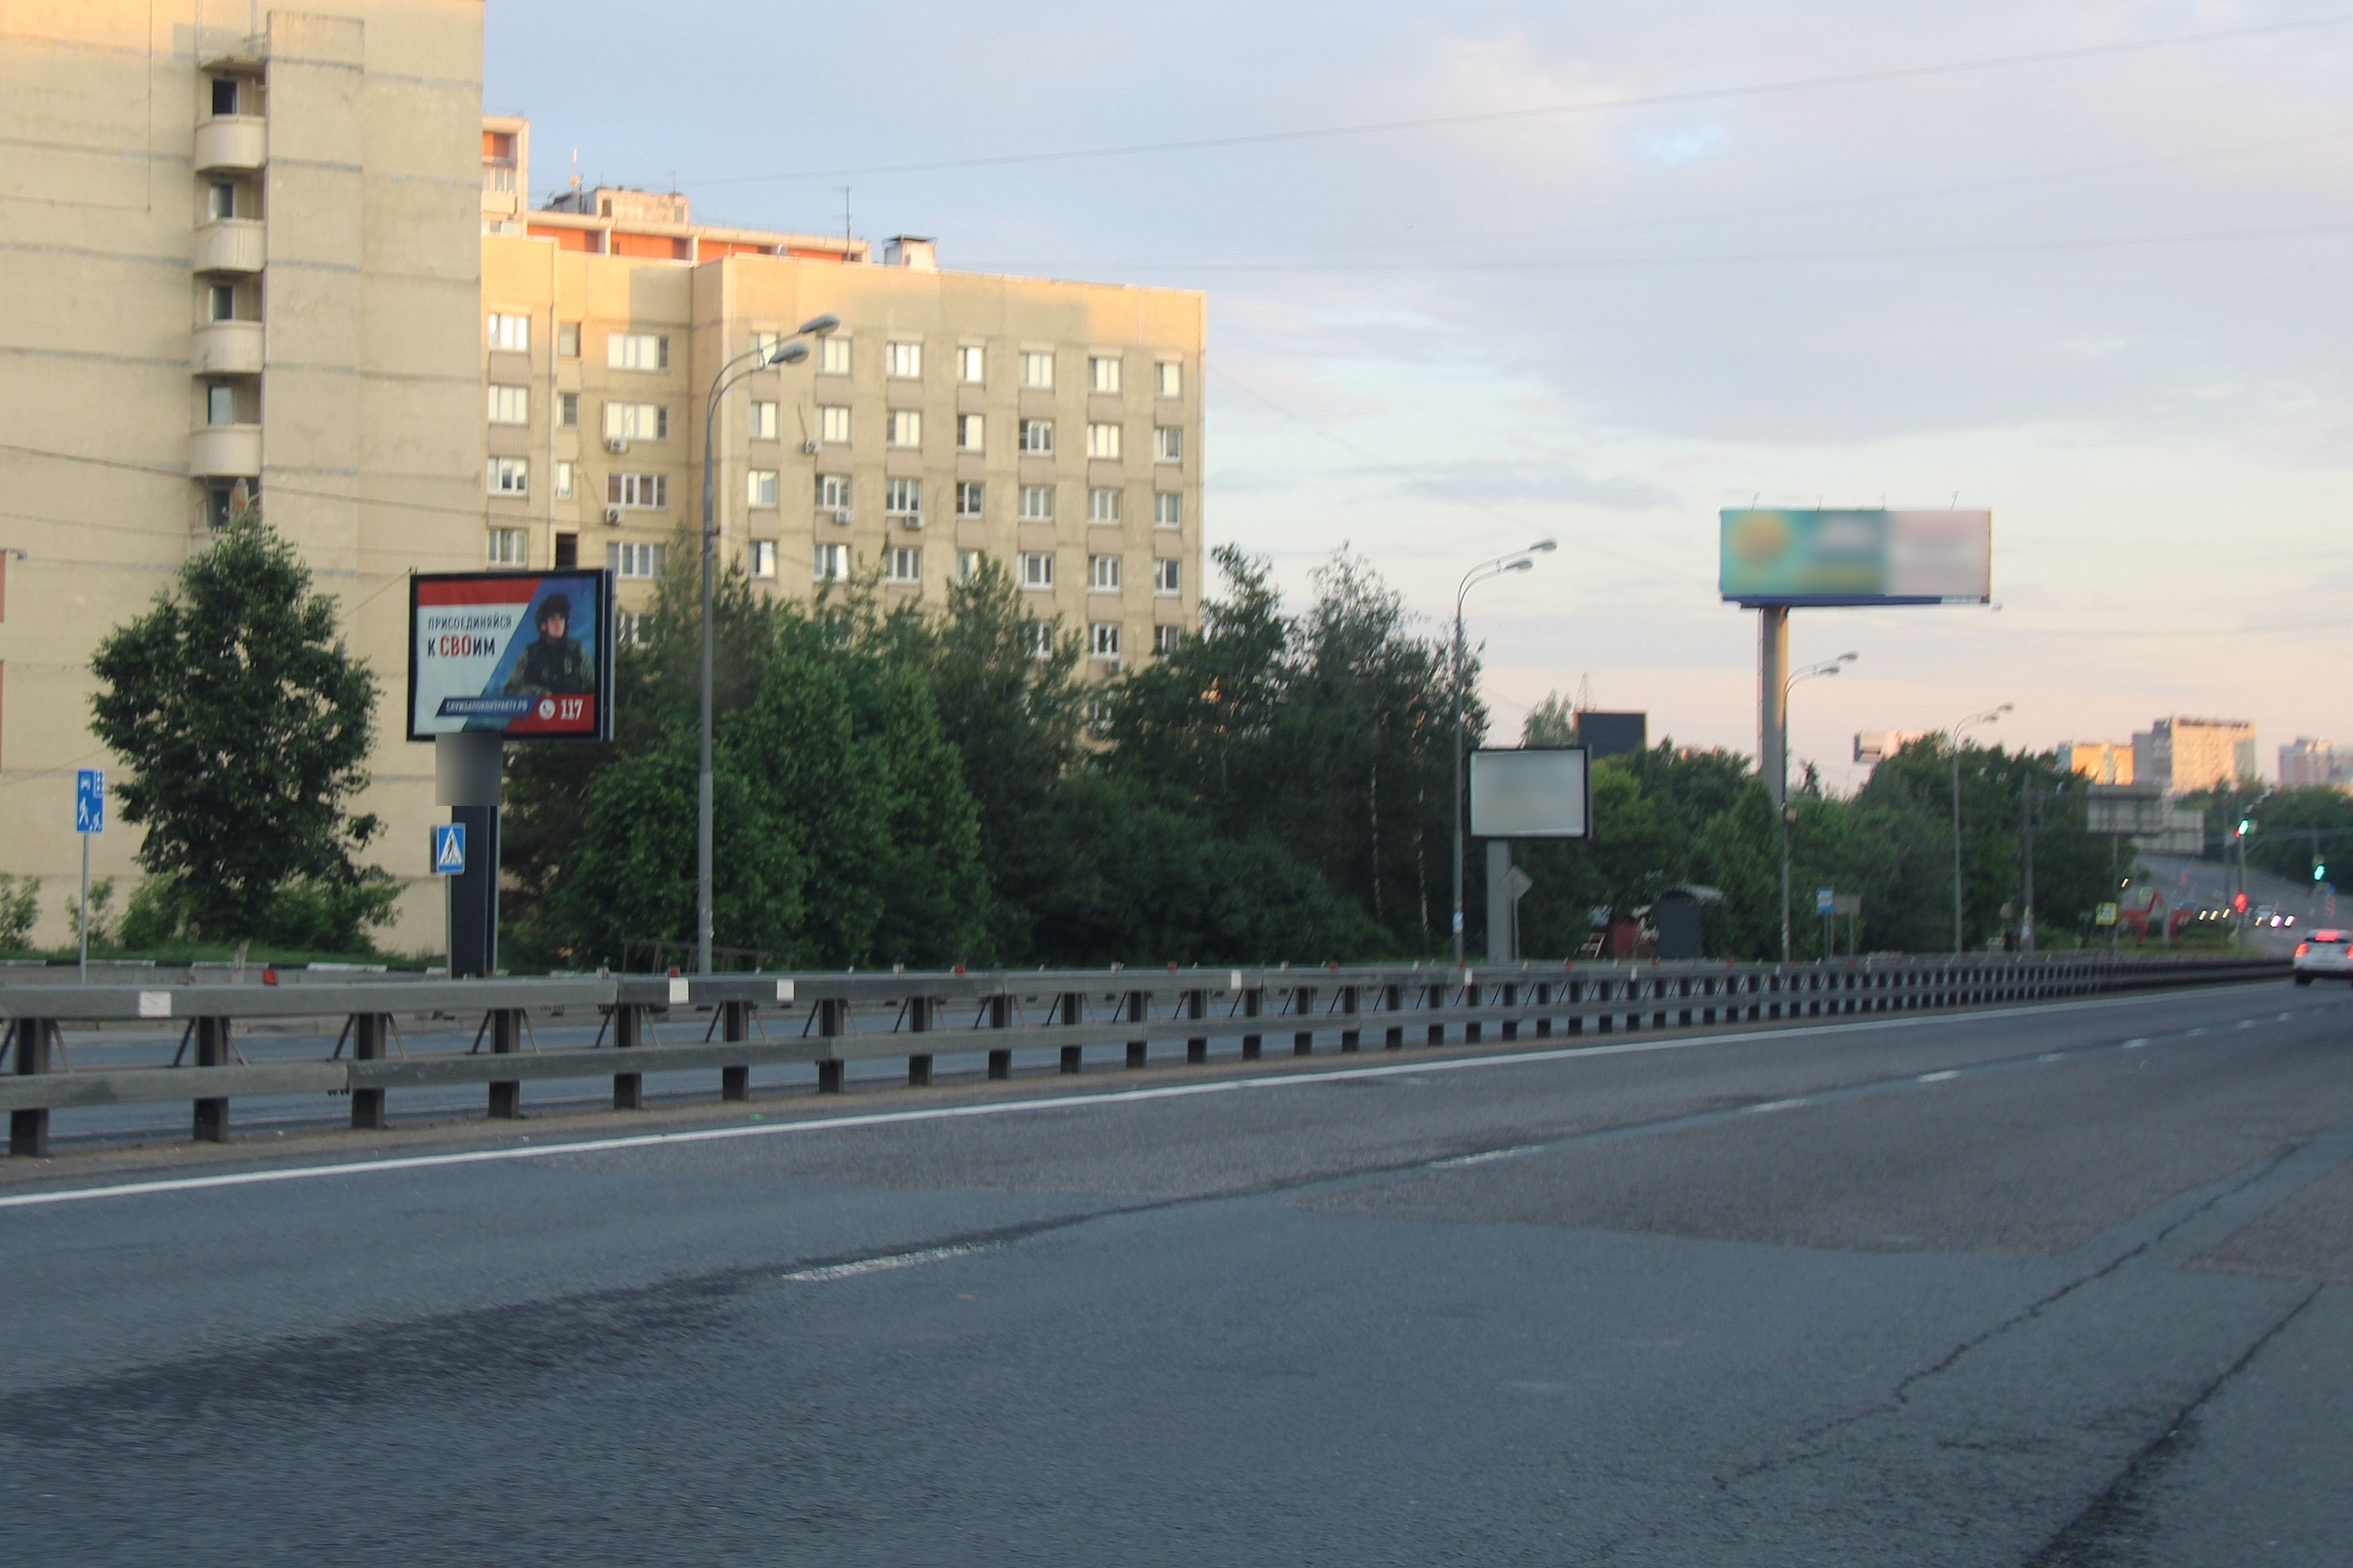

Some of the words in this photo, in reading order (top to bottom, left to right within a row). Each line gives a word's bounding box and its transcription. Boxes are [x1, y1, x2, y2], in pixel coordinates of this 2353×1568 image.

[428, 613, 512, 631] ПРИСОЕДИНЯЙСЯ
[428, 637, 436, 657] К
[440, 634, 495, 657] СВОИМ
[560, 699, 584, 720] 117
